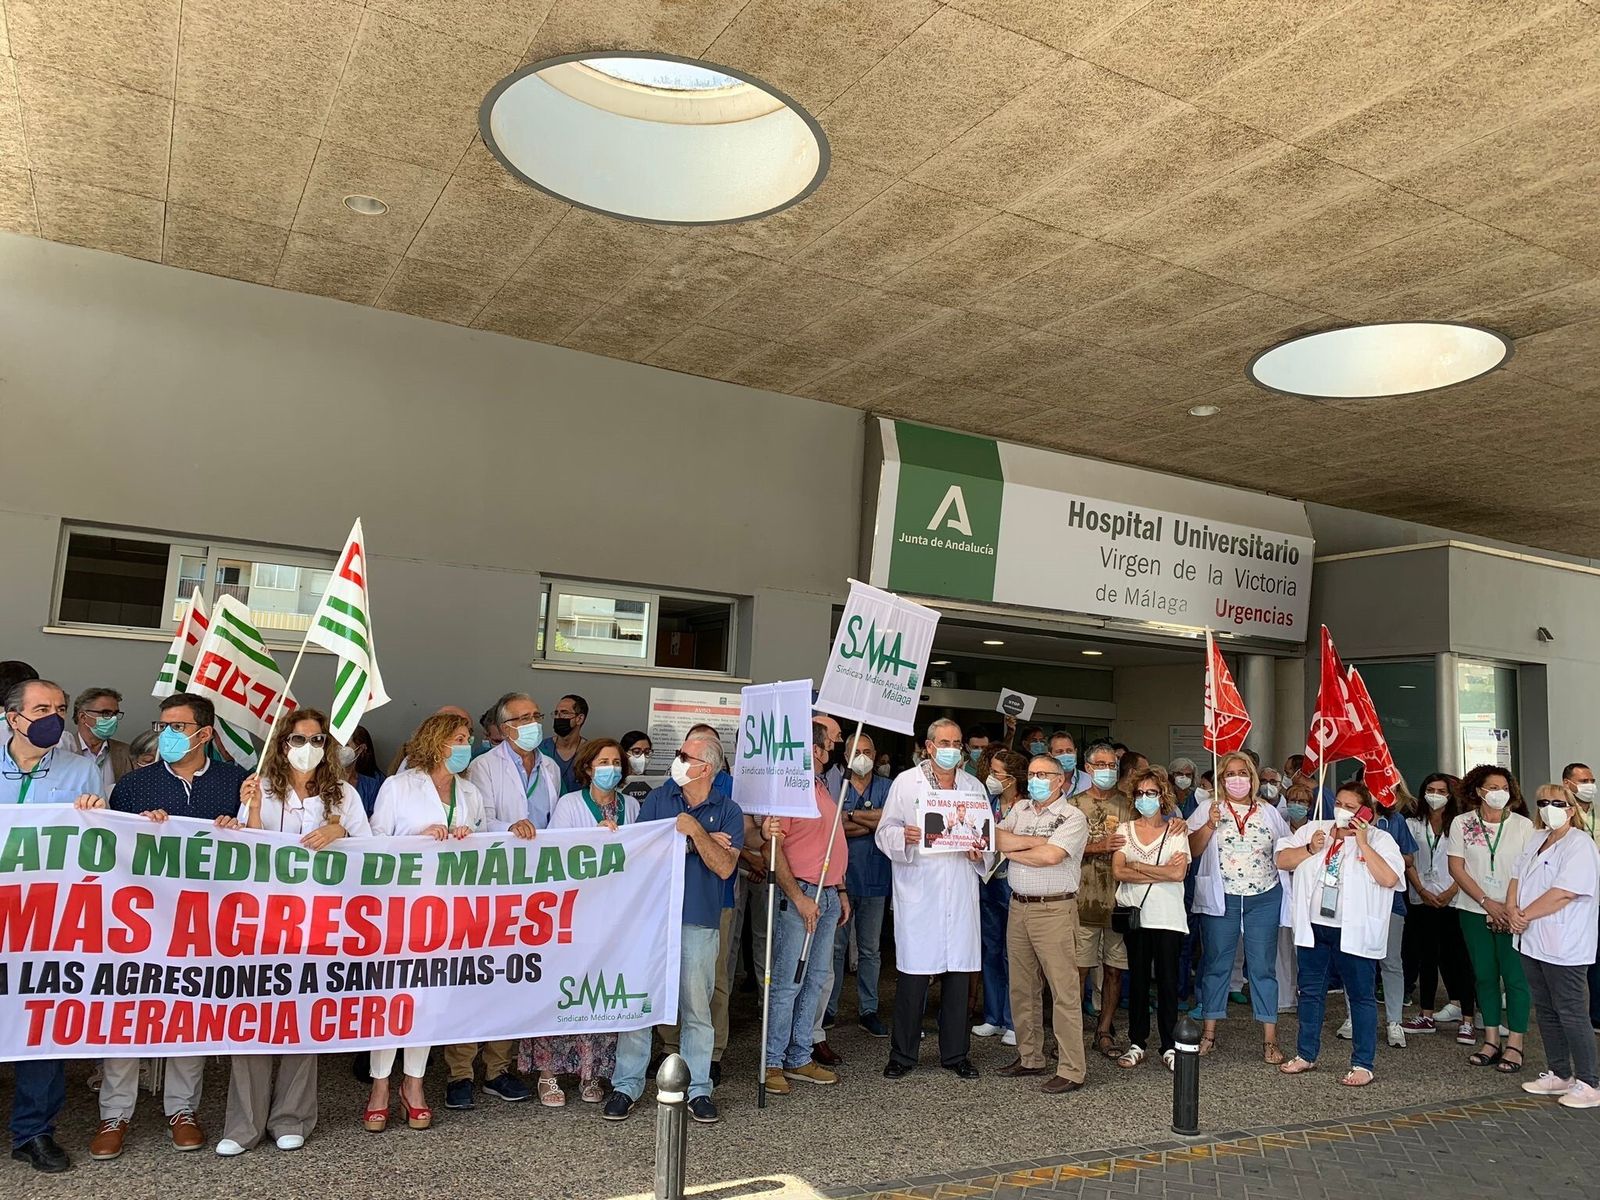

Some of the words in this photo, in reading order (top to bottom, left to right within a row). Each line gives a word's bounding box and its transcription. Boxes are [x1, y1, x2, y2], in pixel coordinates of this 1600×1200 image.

[898, 532, 929, 546] Junta
[930, 537, 944, 548] de
[945, 539, 994, 555] Andalucía
[1067, 500, 1163, 541] Hospital
[1173, 519, 1300, 566] Universitario
[1100, 546, 1161, 577] Virgen
[1173, 559, 1197, 581] de
[1208, 563, 1223, 586] la
[1234, 567, 1297, 597] Victoria
[1095, 583, 1118, 603] de
[1124, 587, 1188, 615] Málaga
[1215, 597, 1294, 627] Urgencias
[840, 615, 918, 677] SMA
[881, 688, 912, 706] Málaga
[743, 710, 805, 765] SMA
[784, 776, 810, 791] Málaga
[926, 799, 937, 807] NO
[937, 800, 952, 808] MAS
[0, 825, 117, 873] ATO
[131, 830, 348, 886] MÉDICO
[360, 852, 423, 886] DE
[434, 841, 627, 886] MÁLAGA
[0, 875, 155, 954] MÁS
[166, 888, 580, 958] AGRESIONES!
[18, 960, 85, 995] LAS
[90, 960, 292, 999] AGRESIONES
[298, 962, 318, 995] A
[326, 952, 543, 993] SANITARIAS-OS
[557, 968, 649, 1014] SMA
[24, 998, 301, 1046] TOLERANCIA
[309, 992, 415, 1043] CERO
[556, 1014, 589, 1023] Sindicato
[590, 1013, 616, 1021] Médico
